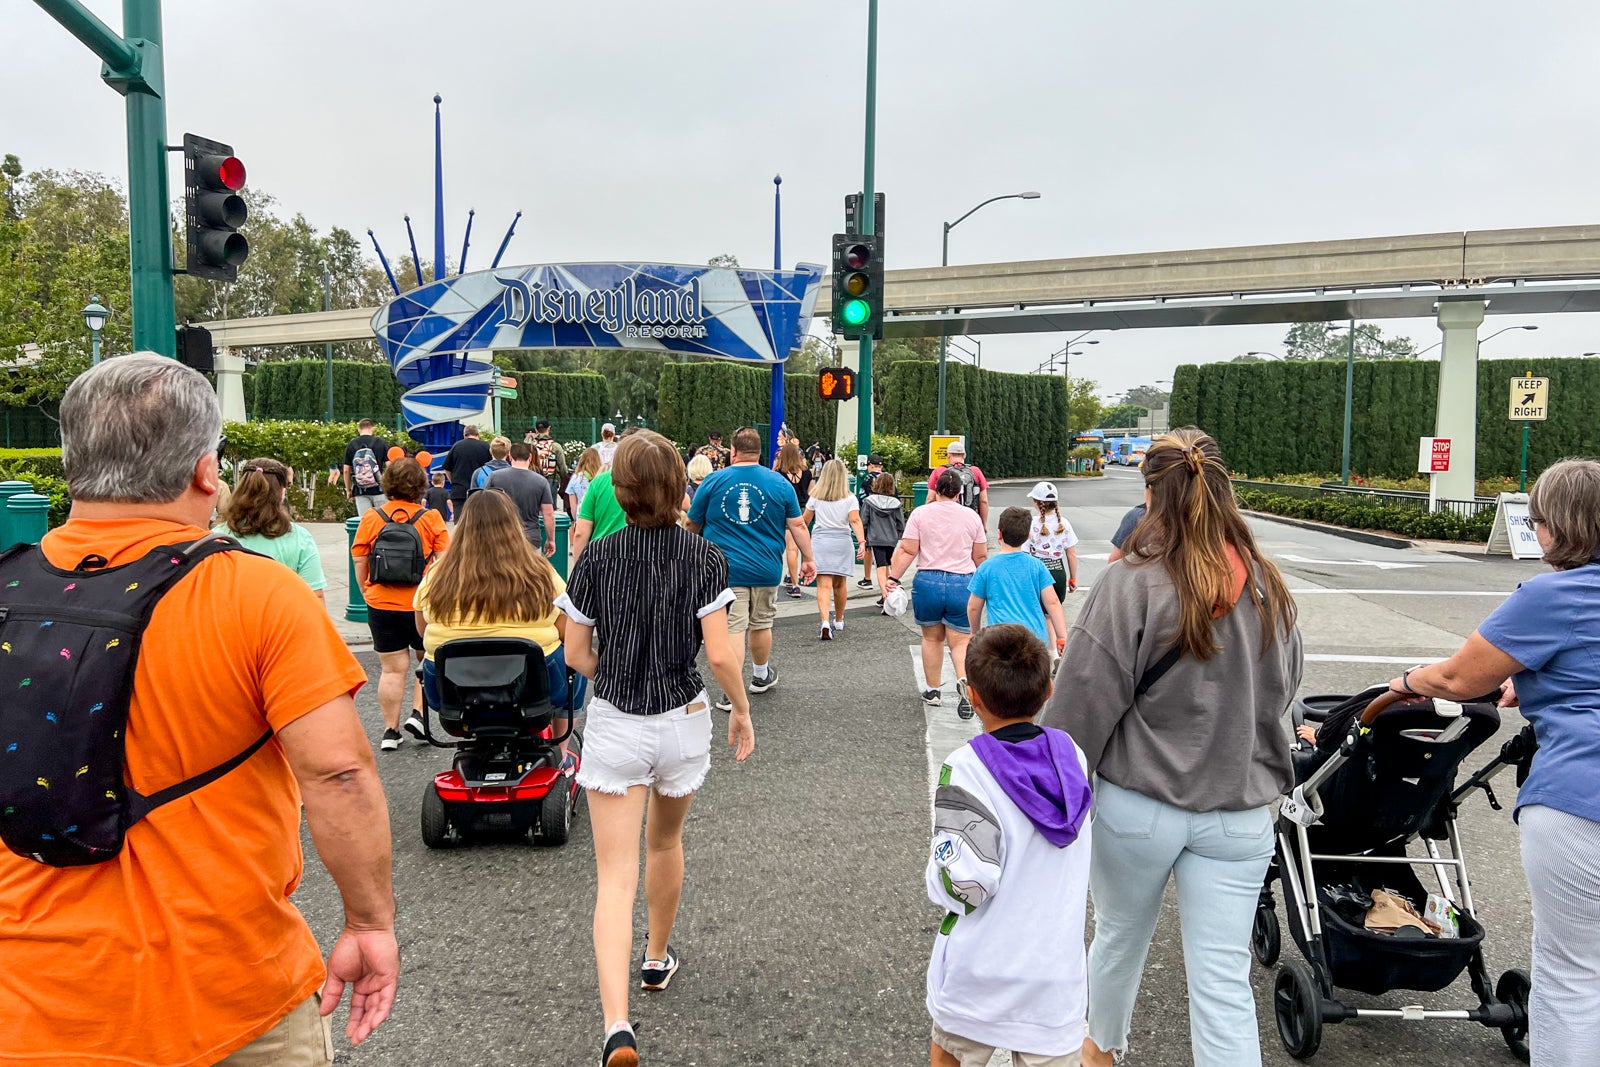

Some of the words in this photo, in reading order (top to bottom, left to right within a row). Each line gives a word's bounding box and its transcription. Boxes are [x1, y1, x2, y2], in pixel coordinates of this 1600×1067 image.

[493, 272, 704, 333] Disneyland
[626, 325, 705, 338] RESORT
[1517, 380, 1543, 390] KEEP
[1514, 407, 1543, 417] RIGHT
[1433, 442, 1450, 452] STOP
[1520, 531, 1537, 542] ONL
